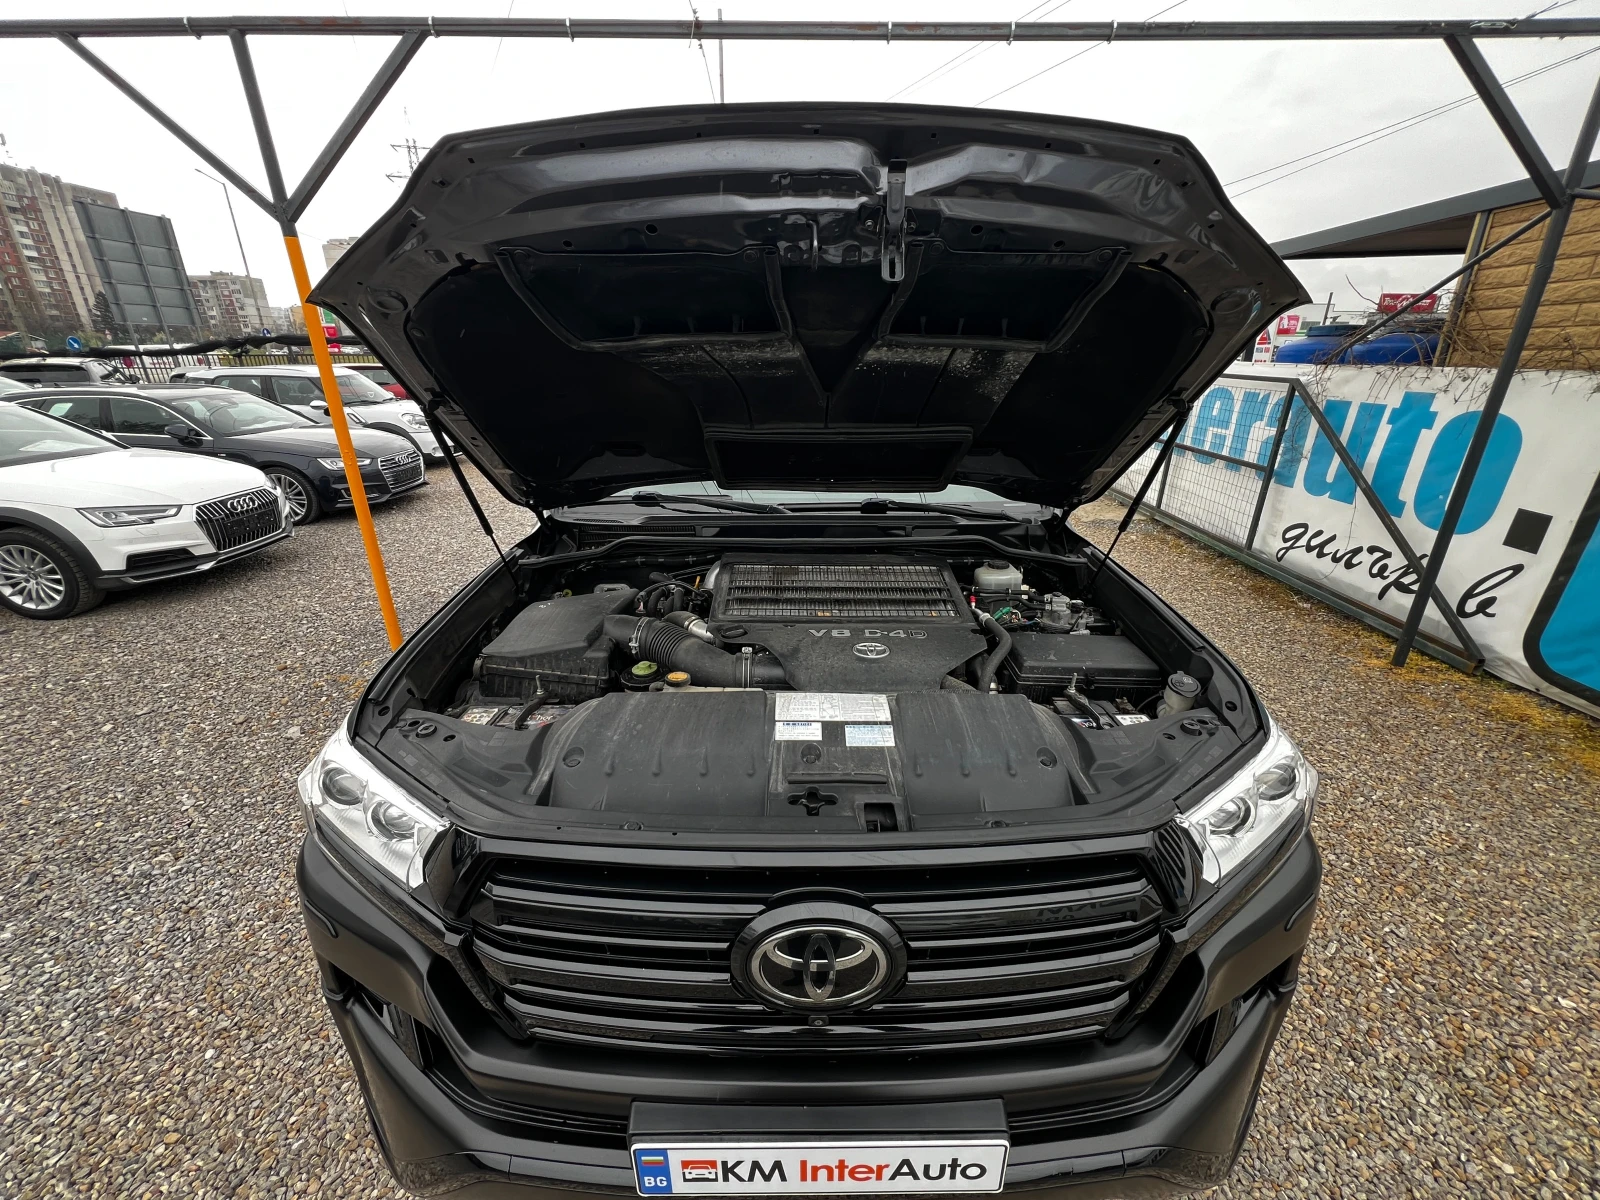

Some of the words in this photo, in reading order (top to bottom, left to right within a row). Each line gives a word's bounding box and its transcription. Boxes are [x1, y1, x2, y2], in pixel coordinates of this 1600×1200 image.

[809, 629, 851, 637] V8
[864, 629, 927, 639] D-4D
[721, 1160, 788, 1182] KM
[799, 1157, 987, 1182] InterAuto
[644, 1176, 668, 1187] BG
